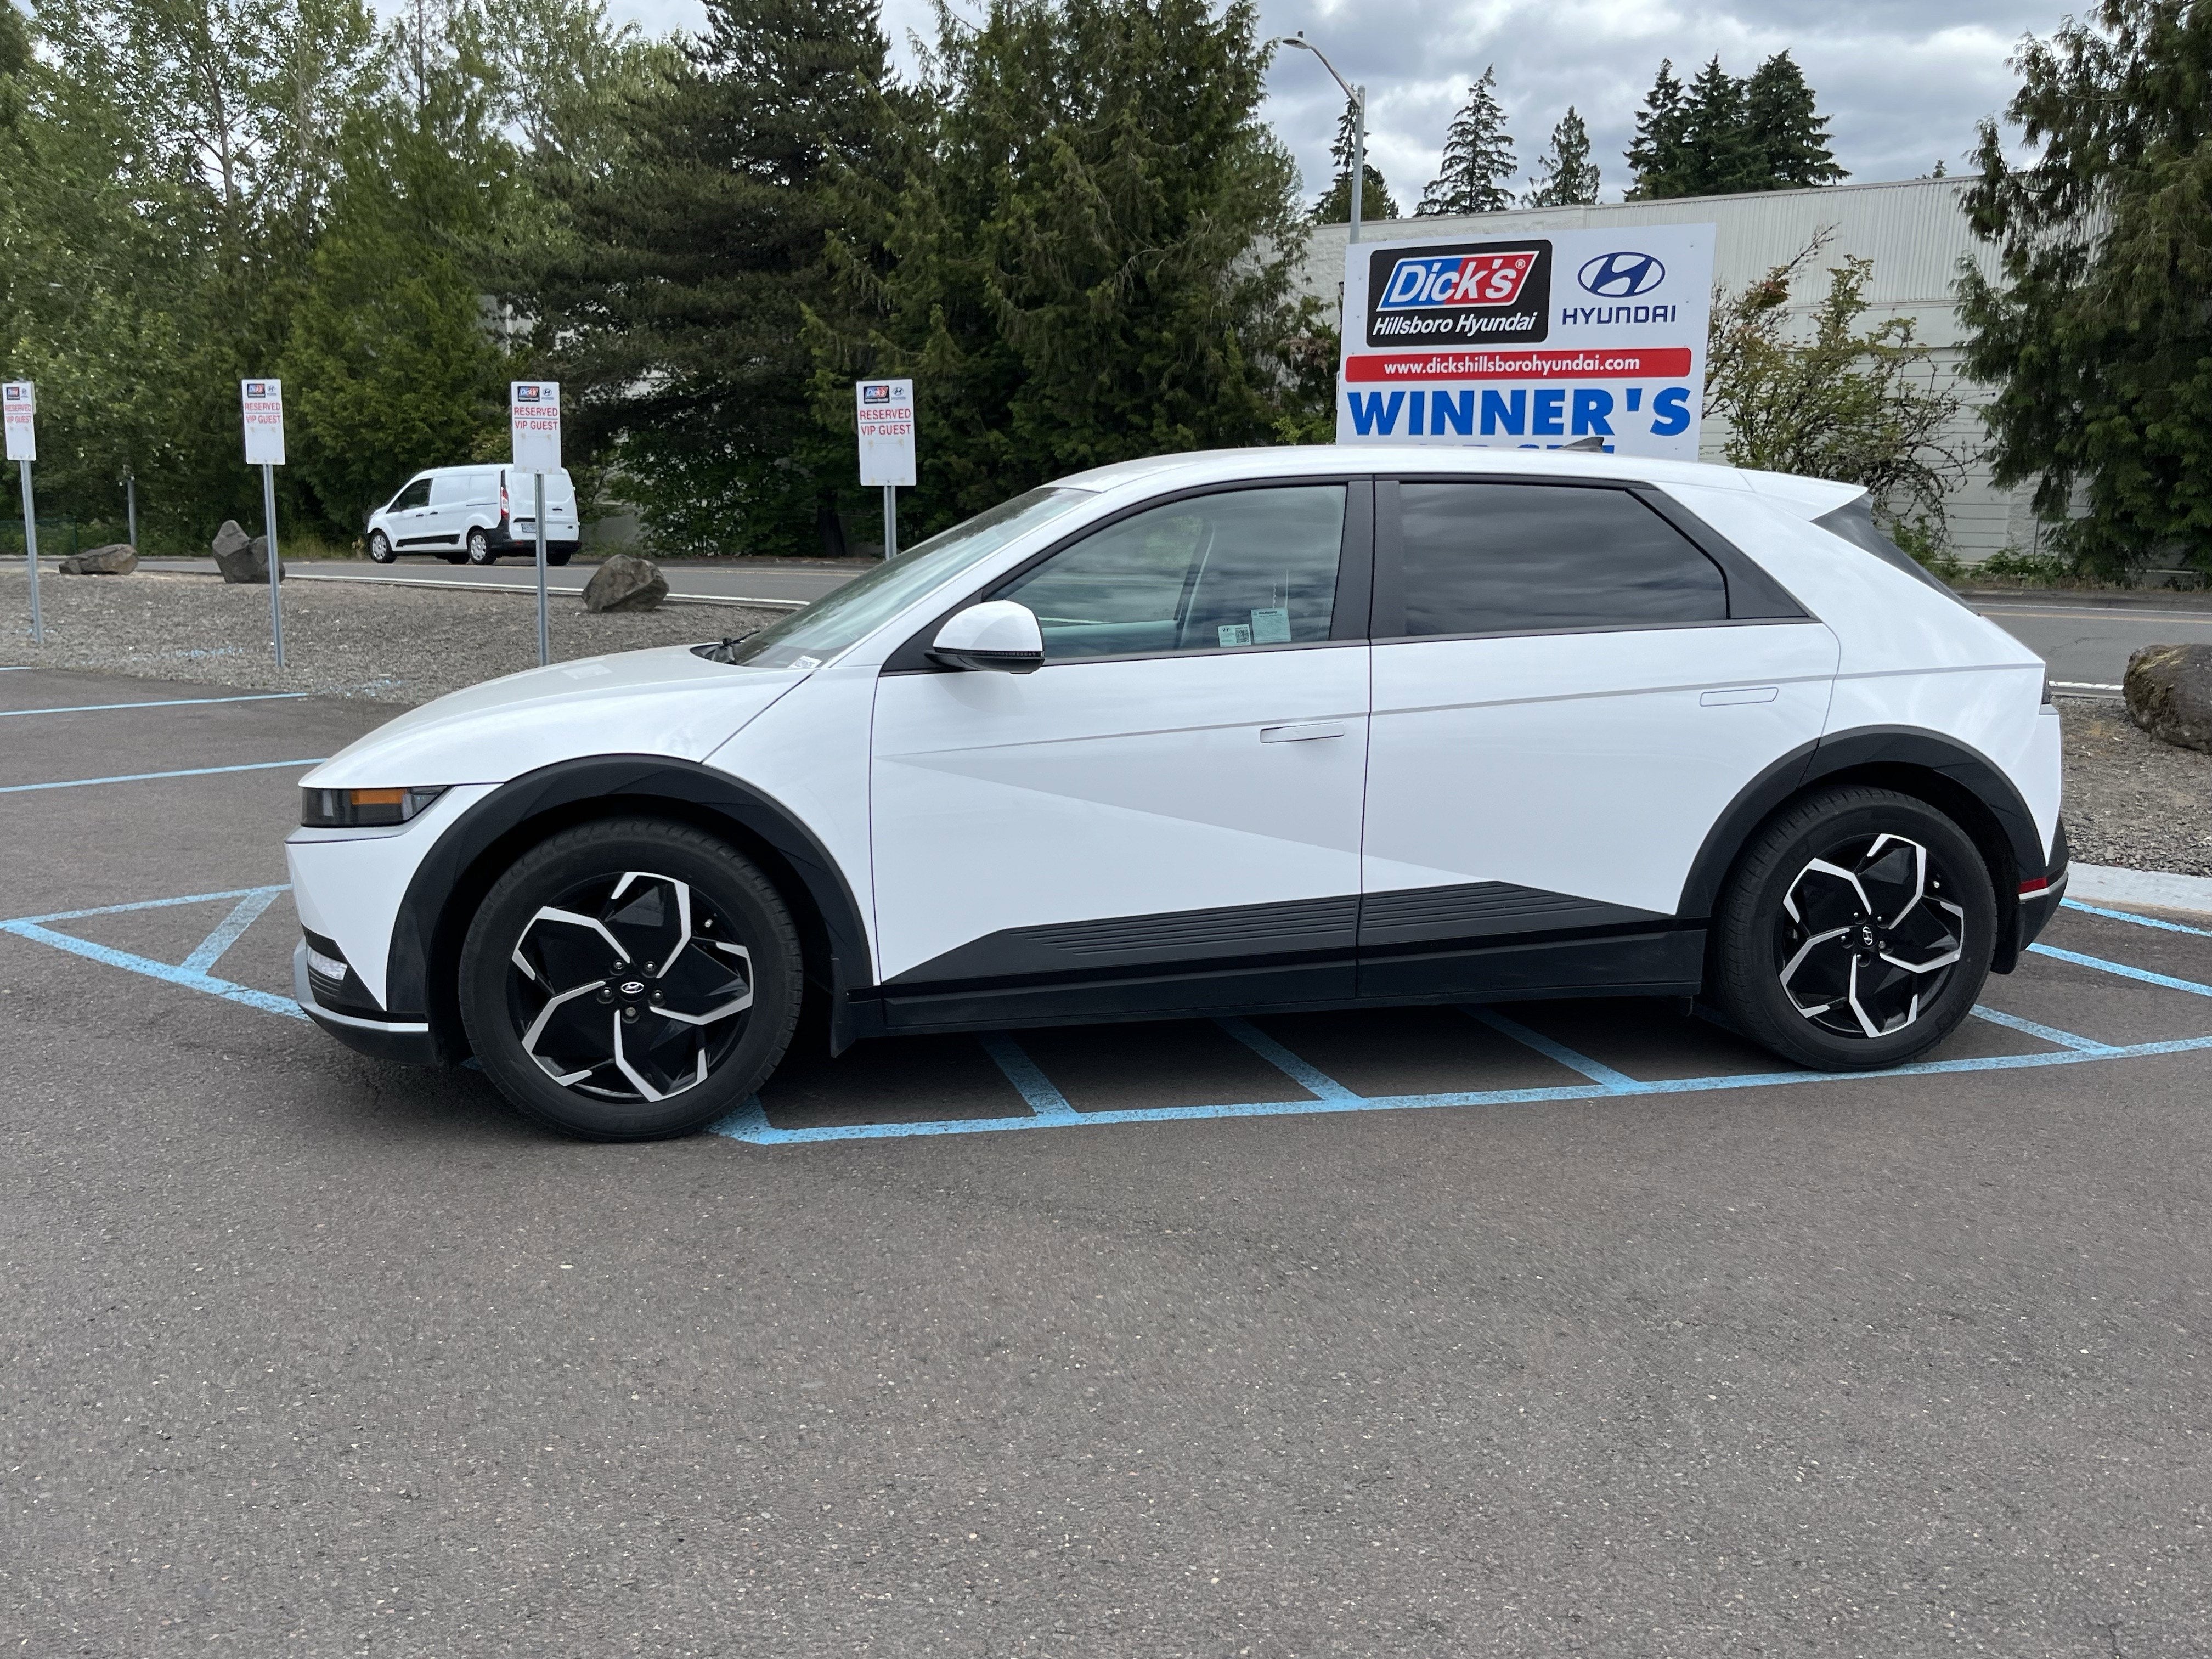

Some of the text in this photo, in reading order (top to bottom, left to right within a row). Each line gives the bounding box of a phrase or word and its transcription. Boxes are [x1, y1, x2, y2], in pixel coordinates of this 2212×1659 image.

[1562, 304, 1677, 325] HYUNDAI
[1372, 312, 1538, 337] Hillsboro Hyundai
[1384, 354, 1640, 376] www.dickshillsborohyundai.com
[245, 402, 281, 411] RESERVED
[514, 407, 558, 416] RESERVED
[1346, 386, 1691, 436] WINNER'S
[258, 415, 281, 424] GUEST
[860, 408, 911, 420] RESERVED
[515, 420, 558, 430] VIP GUEST
[861, 424, 911, 436] VIP GUEST
